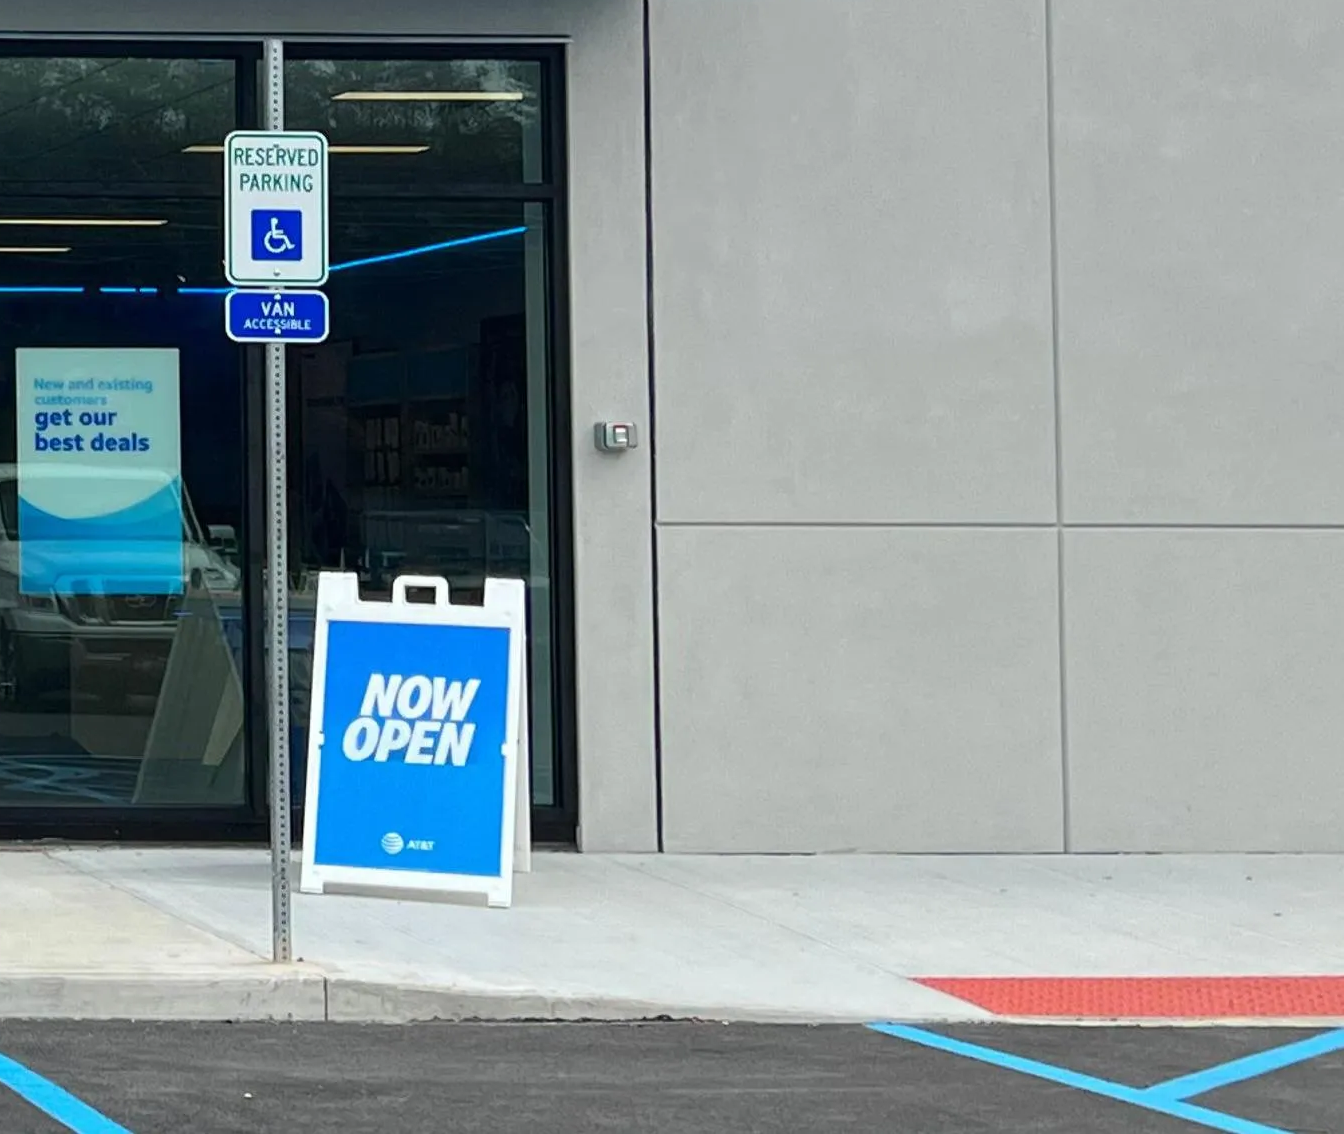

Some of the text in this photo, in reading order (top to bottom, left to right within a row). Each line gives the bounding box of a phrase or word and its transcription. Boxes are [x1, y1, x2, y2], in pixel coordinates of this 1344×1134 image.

[234, 147, 319, 167] RESERVED
[239, 173, 314, 193] PARKING
[261, 302, 295, 317] VAN
[243, 319, 312, 330] ACCESSIBLE
[34, 377, 153, 394] New and existing
[34, 395, 108, 406] customers
[34, 409, 117, 431] get our
[34, 432, 150, 452] best deals
[360, 673, 481, 721] NOW
[342, 717, 476, 767] OPEN
[406, 840, 435, 851] AT&T
